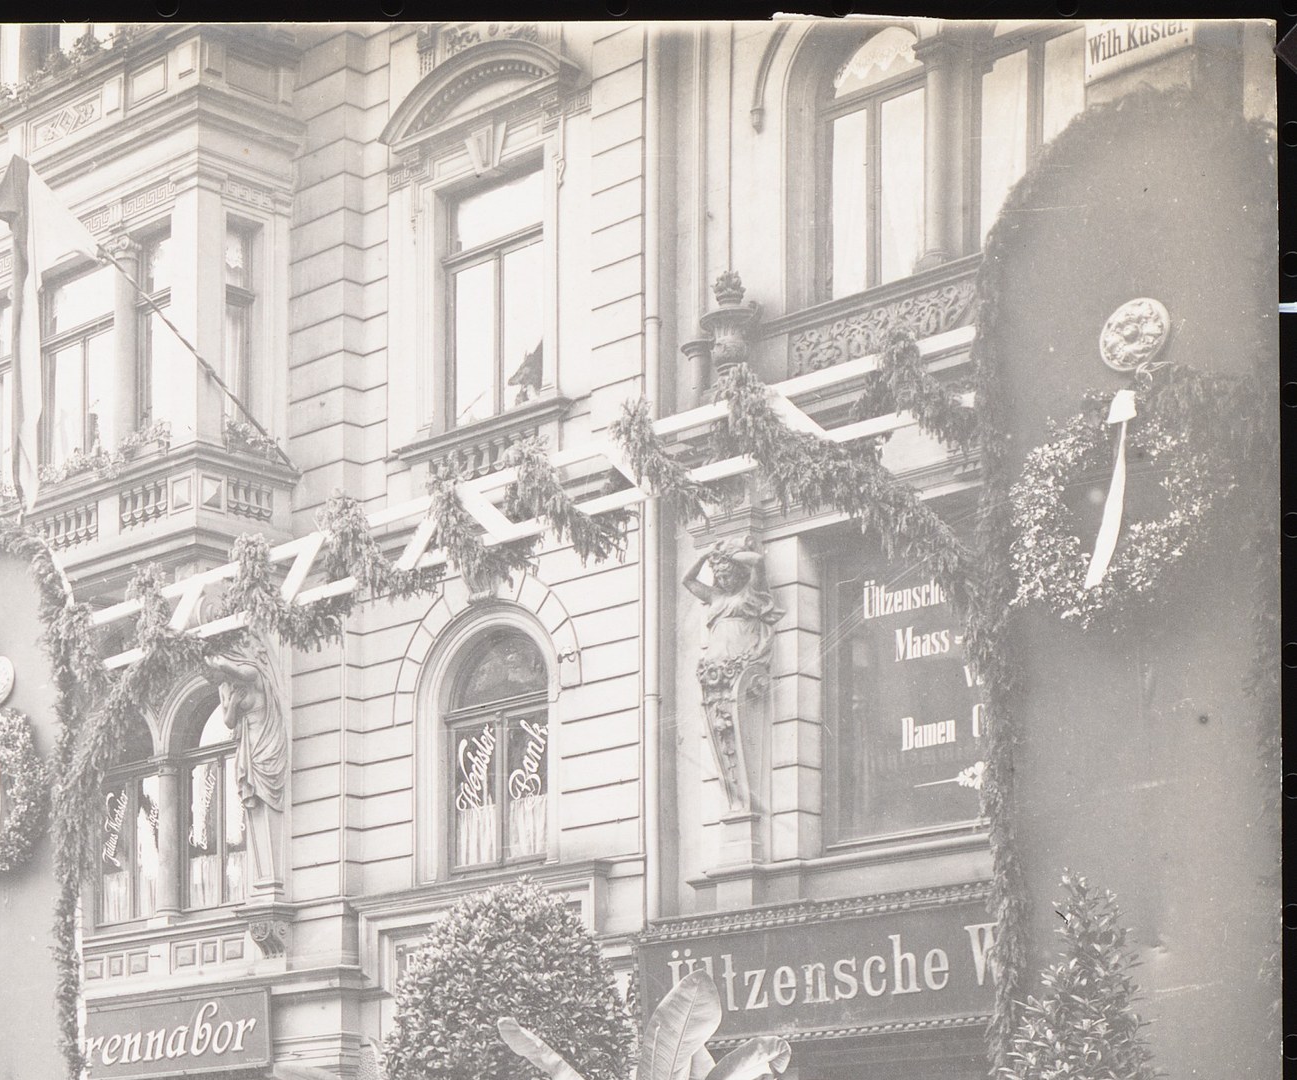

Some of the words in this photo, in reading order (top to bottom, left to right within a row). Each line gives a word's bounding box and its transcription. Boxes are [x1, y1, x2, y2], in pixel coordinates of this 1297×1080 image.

[901, 716, 956, 751] Damen
[102, 834, 120, 867] Julius
[86, 1001, 257, 1067] rennabor
